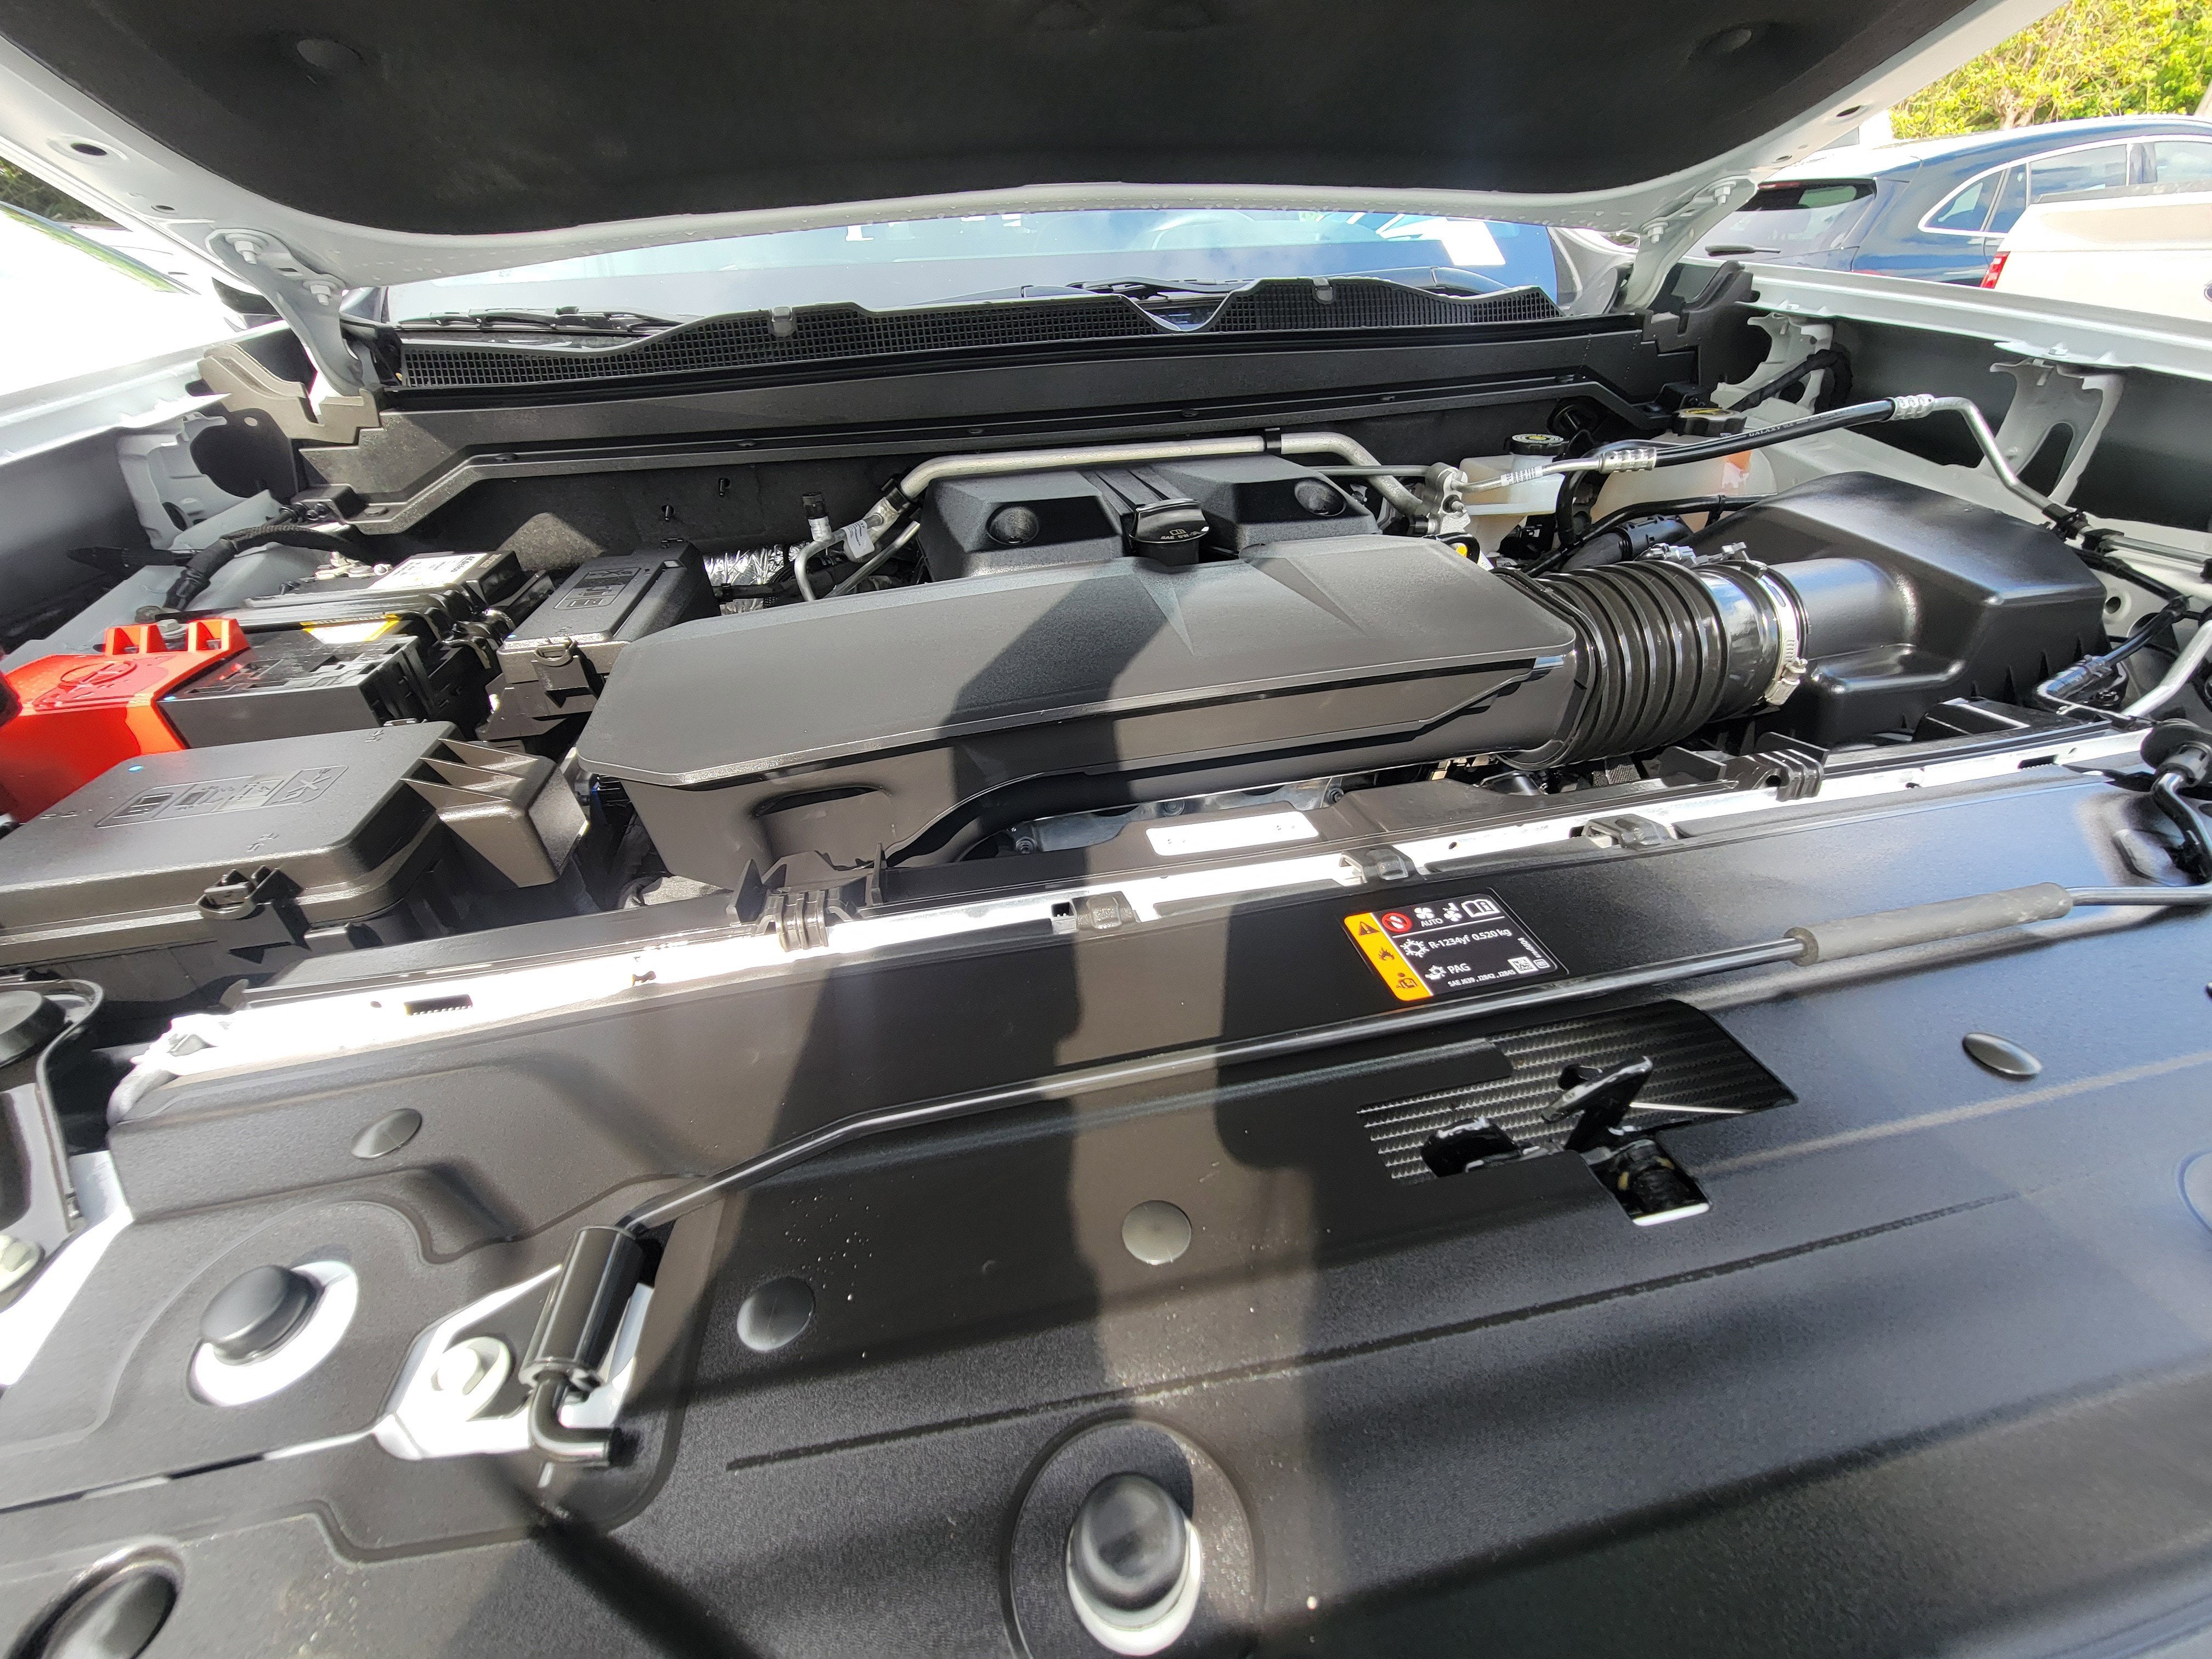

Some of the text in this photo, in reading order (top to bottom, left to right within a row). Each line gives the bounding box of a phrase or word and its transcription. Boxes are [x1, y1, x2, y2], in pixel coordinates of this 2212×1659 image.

[1748, 426, 1781, 437] GALAXY
[1420, 918, 1443, 927] AUTO
[1428, 935, 1471, 949] R-1234yf
[1471, 930, 1498, 941] 0.520
[1447, 963, 1471, 974] PAG
